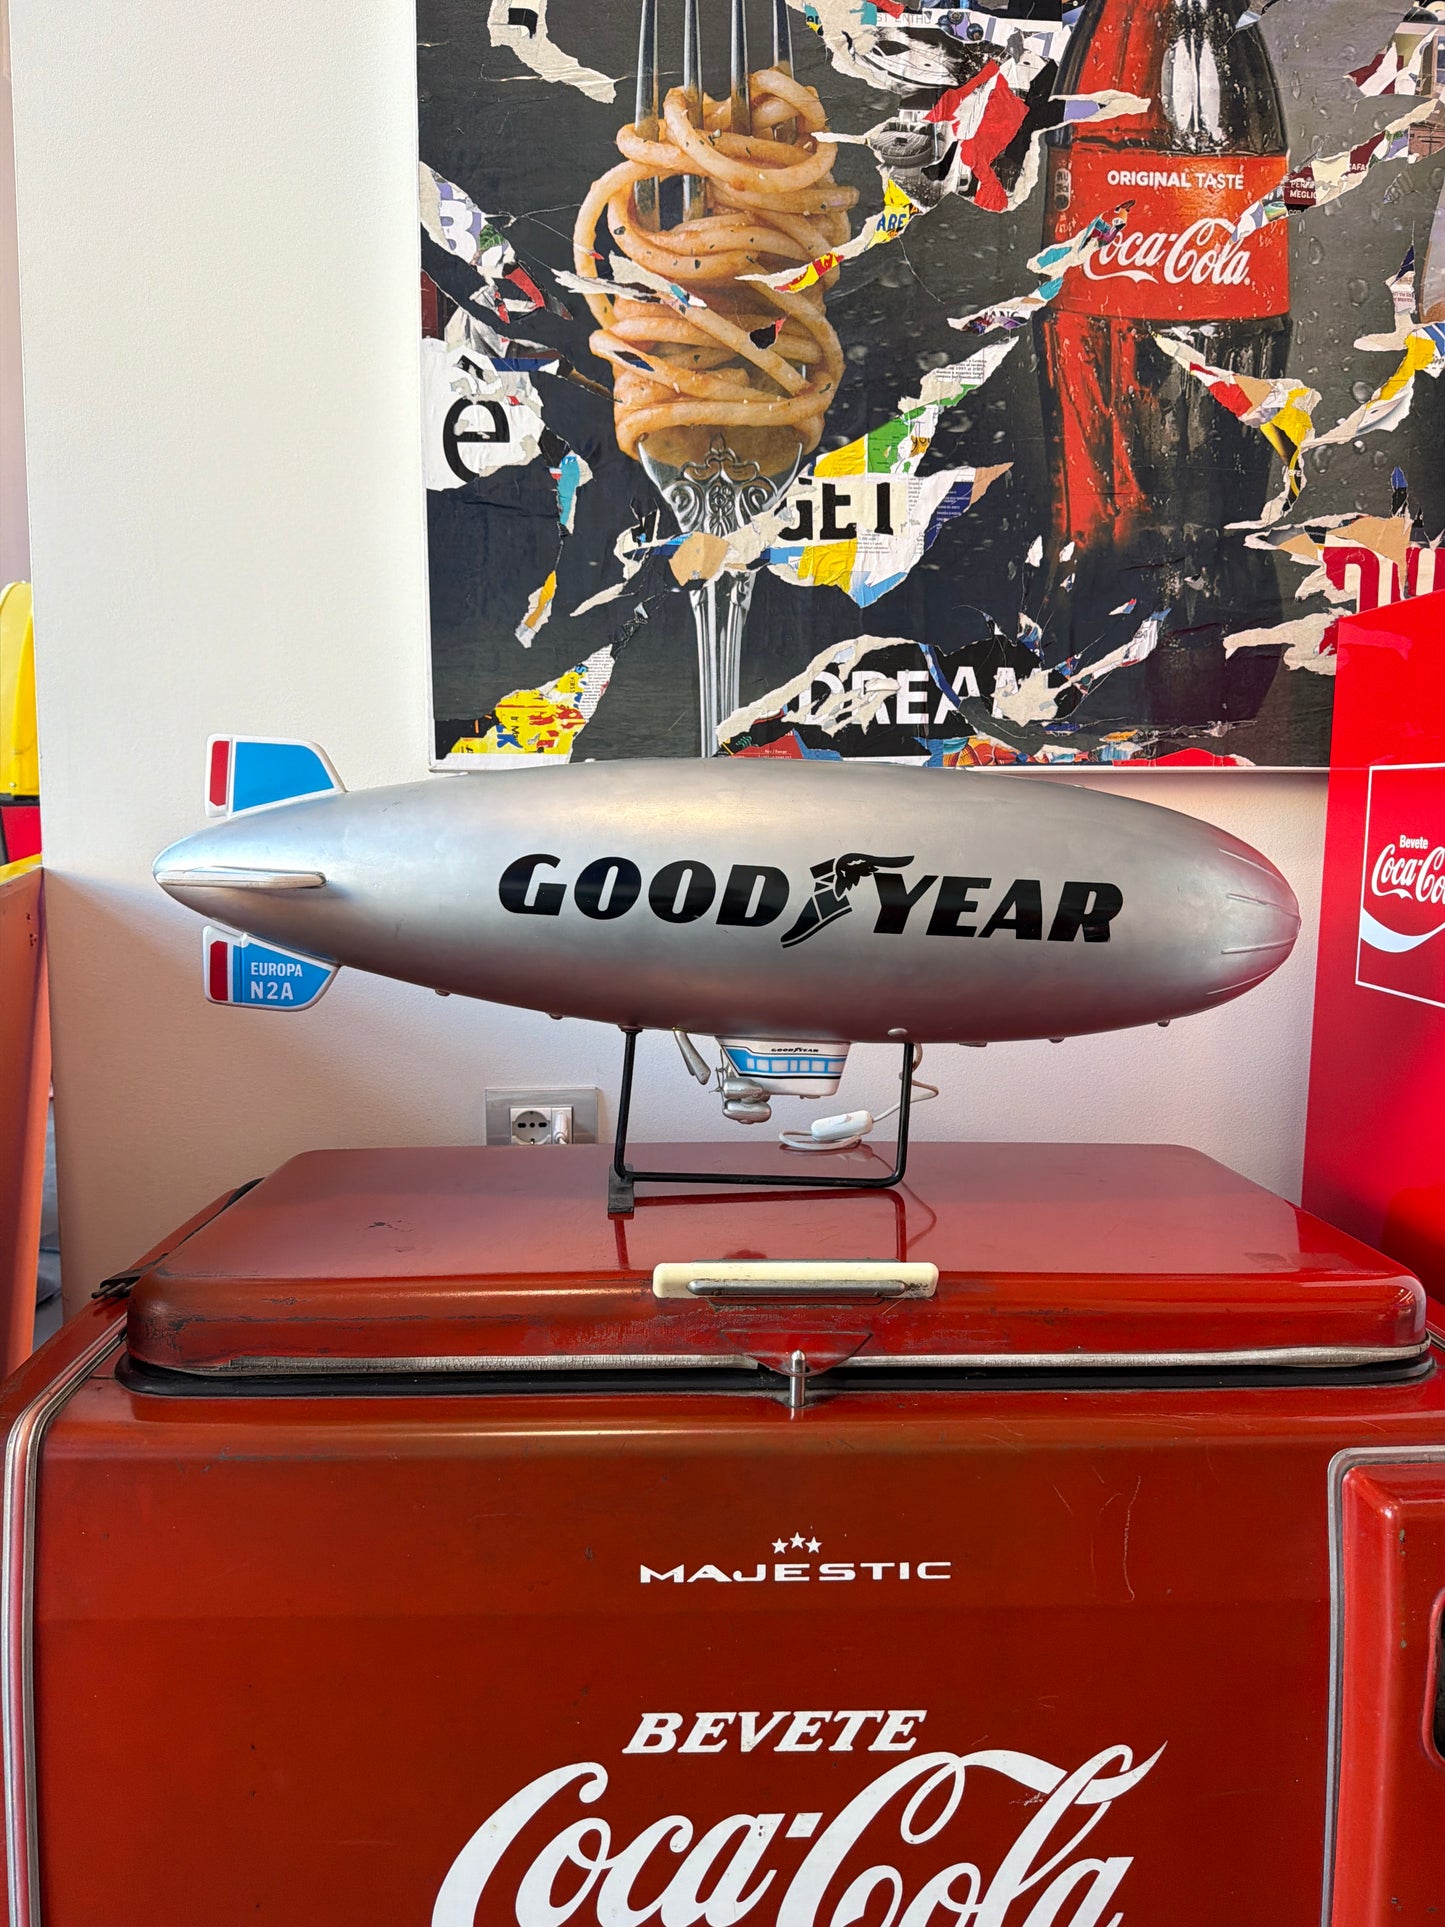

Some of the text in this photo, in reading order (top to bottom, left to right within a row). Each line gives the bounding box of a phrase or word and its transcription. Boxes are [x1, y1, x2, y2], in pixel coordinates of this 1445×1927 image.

[1107, 170, 1244, 190] ORIGINAL TASTE
[1400, 834, 1428, 849] Bevete
[250, 962, 303, 977] EUROPA
[250, 981, 294, 1000] N2A
[640, 1561, 952, 1583] MAJESTIC
[622, 1709, 928, 1755] BEVETE
[431, 1739, 1168, 1927] Coca-Cola
